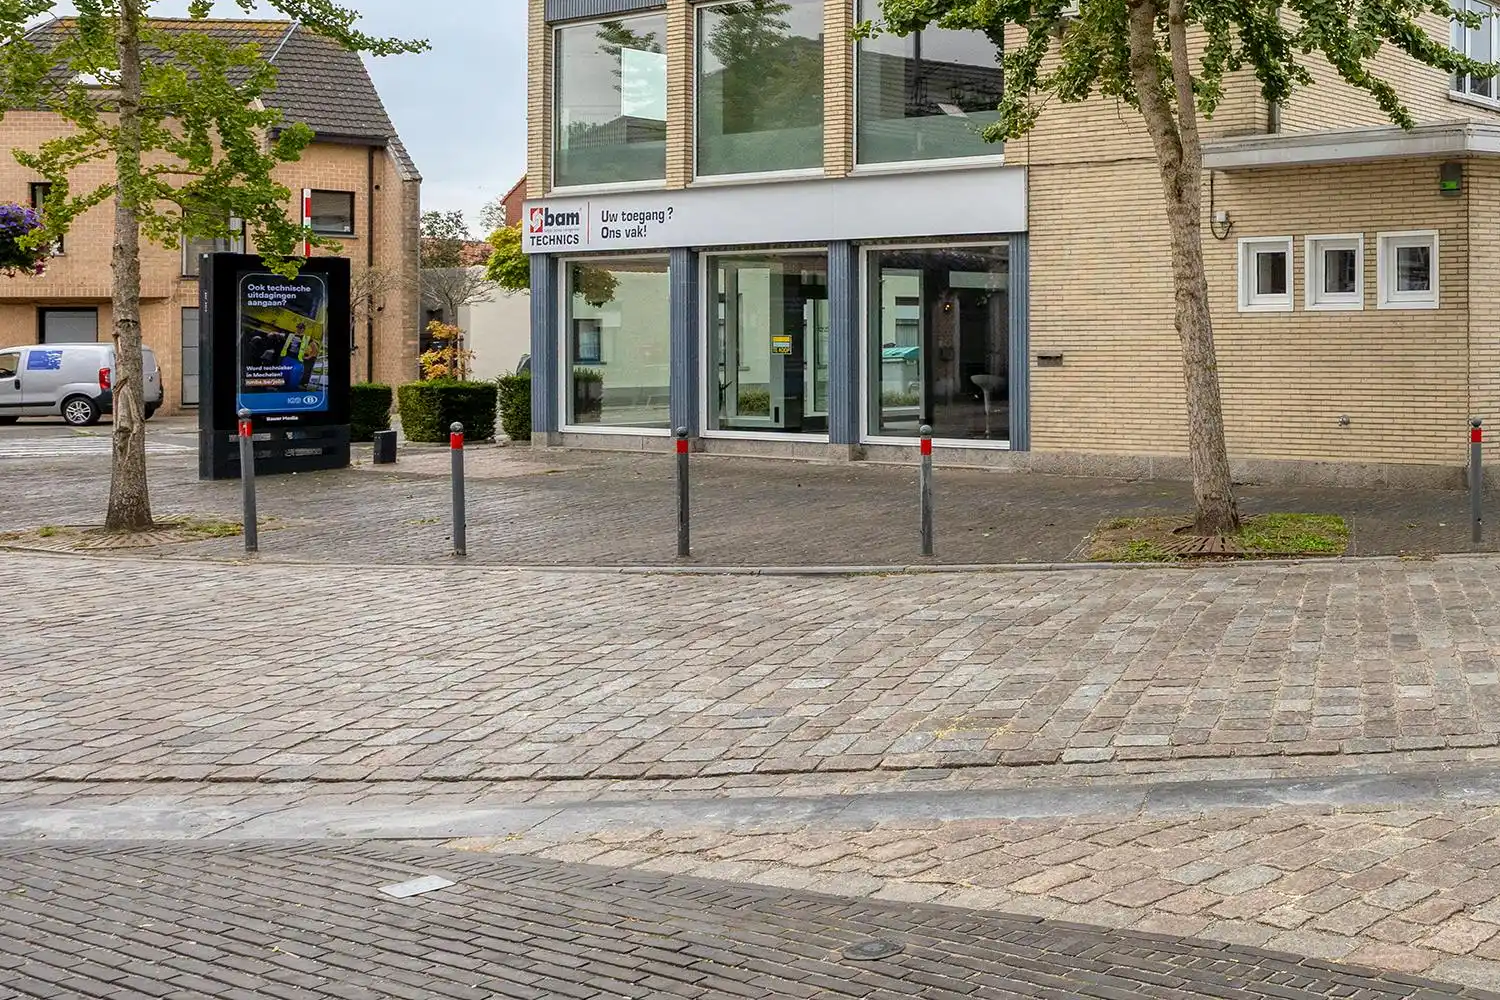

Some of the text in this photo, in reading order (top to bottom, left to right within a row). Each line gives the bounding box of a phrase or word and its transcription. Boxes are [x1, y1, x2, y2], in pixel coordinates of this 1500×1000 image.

[544, 207, 580, 226] bam
[601, 210, 618, 223] Uw
[601, 225, 647, 239] Ons vak!
[530, 234, 579, 246] TECHNICS
[248, 292, 296, 300] uitdagingen
